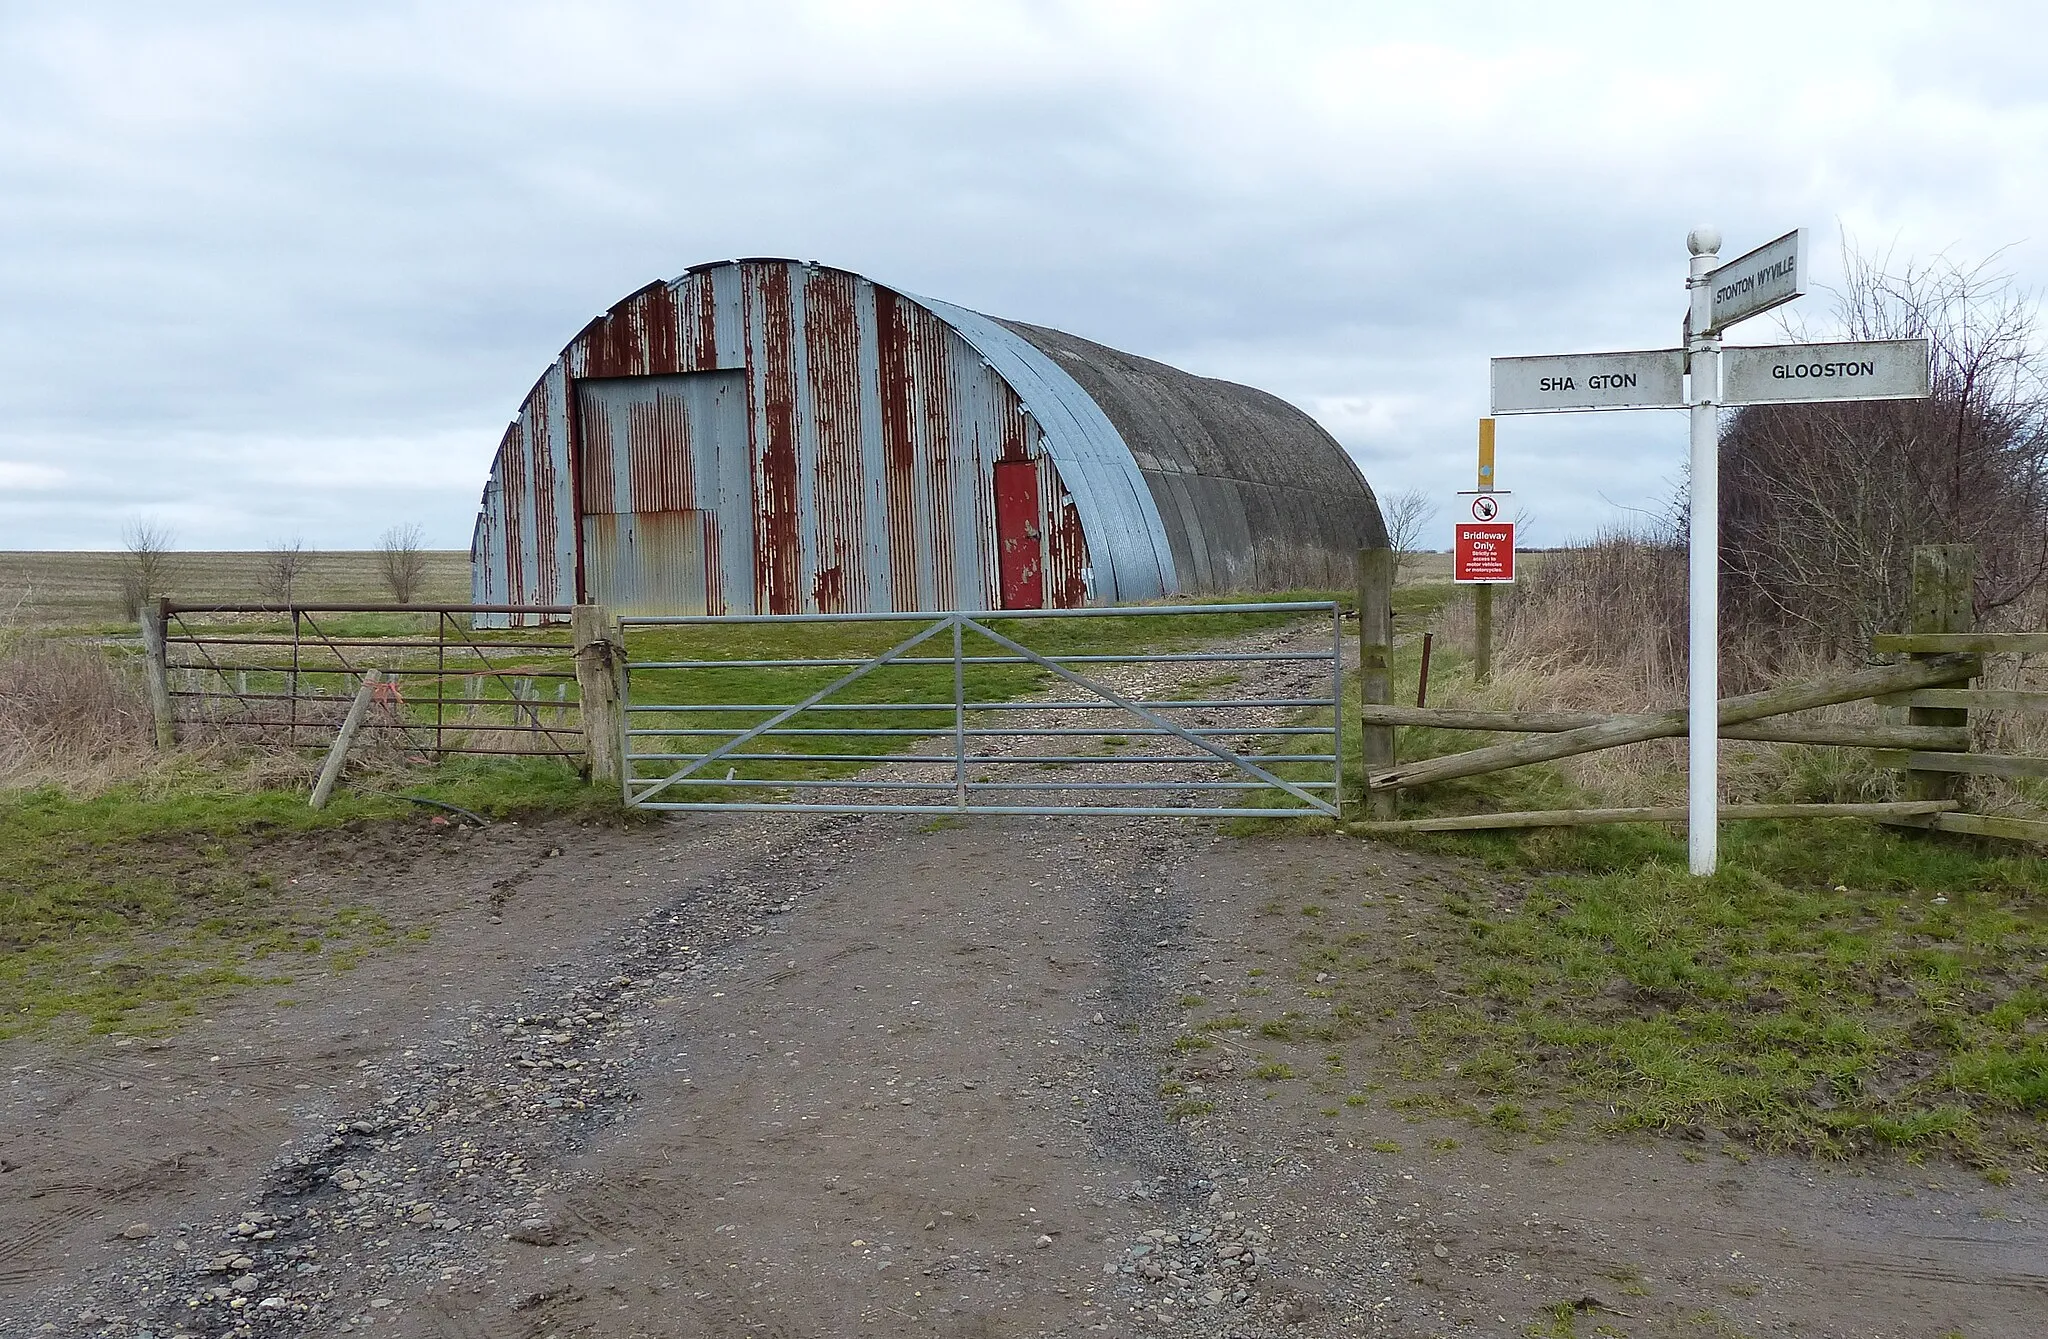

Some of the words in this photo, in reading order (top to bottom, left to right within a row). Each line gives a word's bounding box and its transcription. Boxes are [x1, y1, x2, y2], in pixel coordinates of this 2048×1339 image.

[1716, 274, 1755, 304] STONTON
[1757, 255, 1794, 286] WYVILLE
[1772, 361, 1874, 379] GLOOSTON
[1539, 373, 1637, 391] SHAGTON
[1463, 531, 1507, 541] Bridleway
[1473, 541, 1496, 551] Only.
